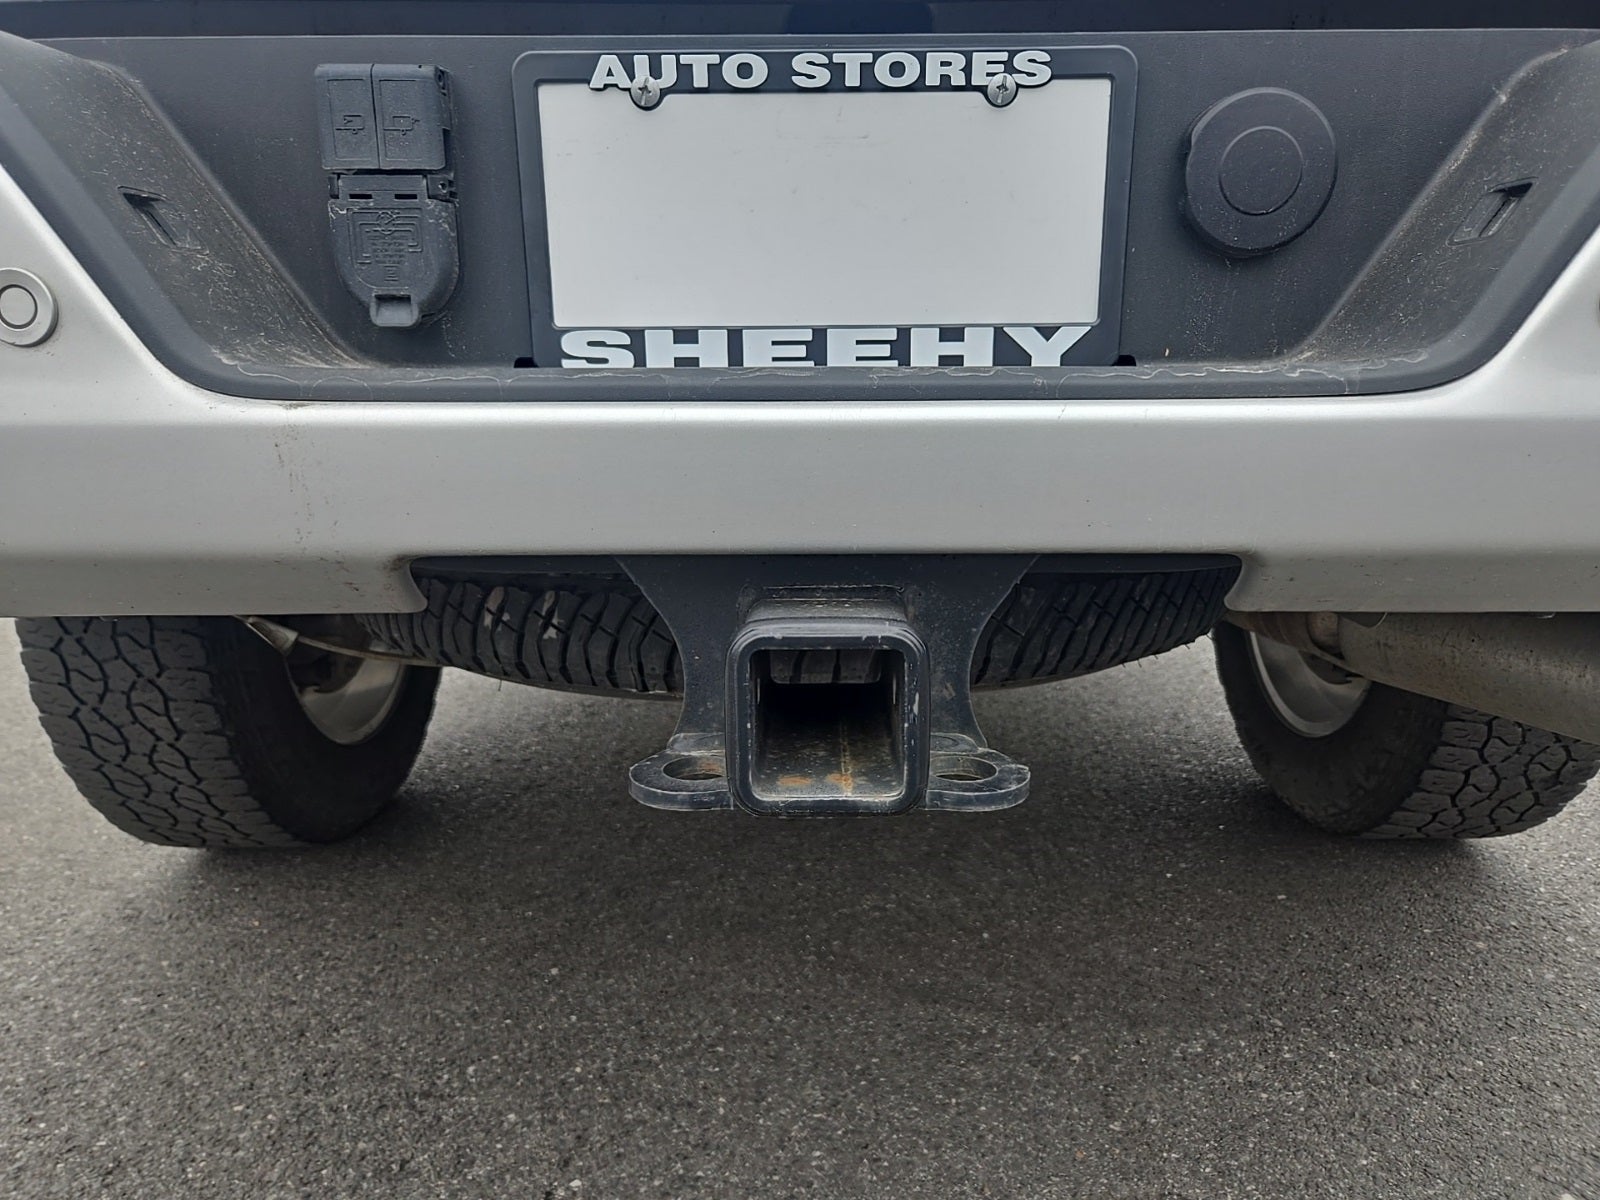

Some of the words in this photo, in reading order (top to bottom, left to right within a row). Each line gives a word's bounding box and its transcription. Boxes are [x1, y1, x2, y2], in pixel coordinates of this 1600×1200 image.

[589, 53, 769, 90] AUTO
[791, 50, 1053, 89] STORES
[560, 326, 1092, 369] SHEEHY
